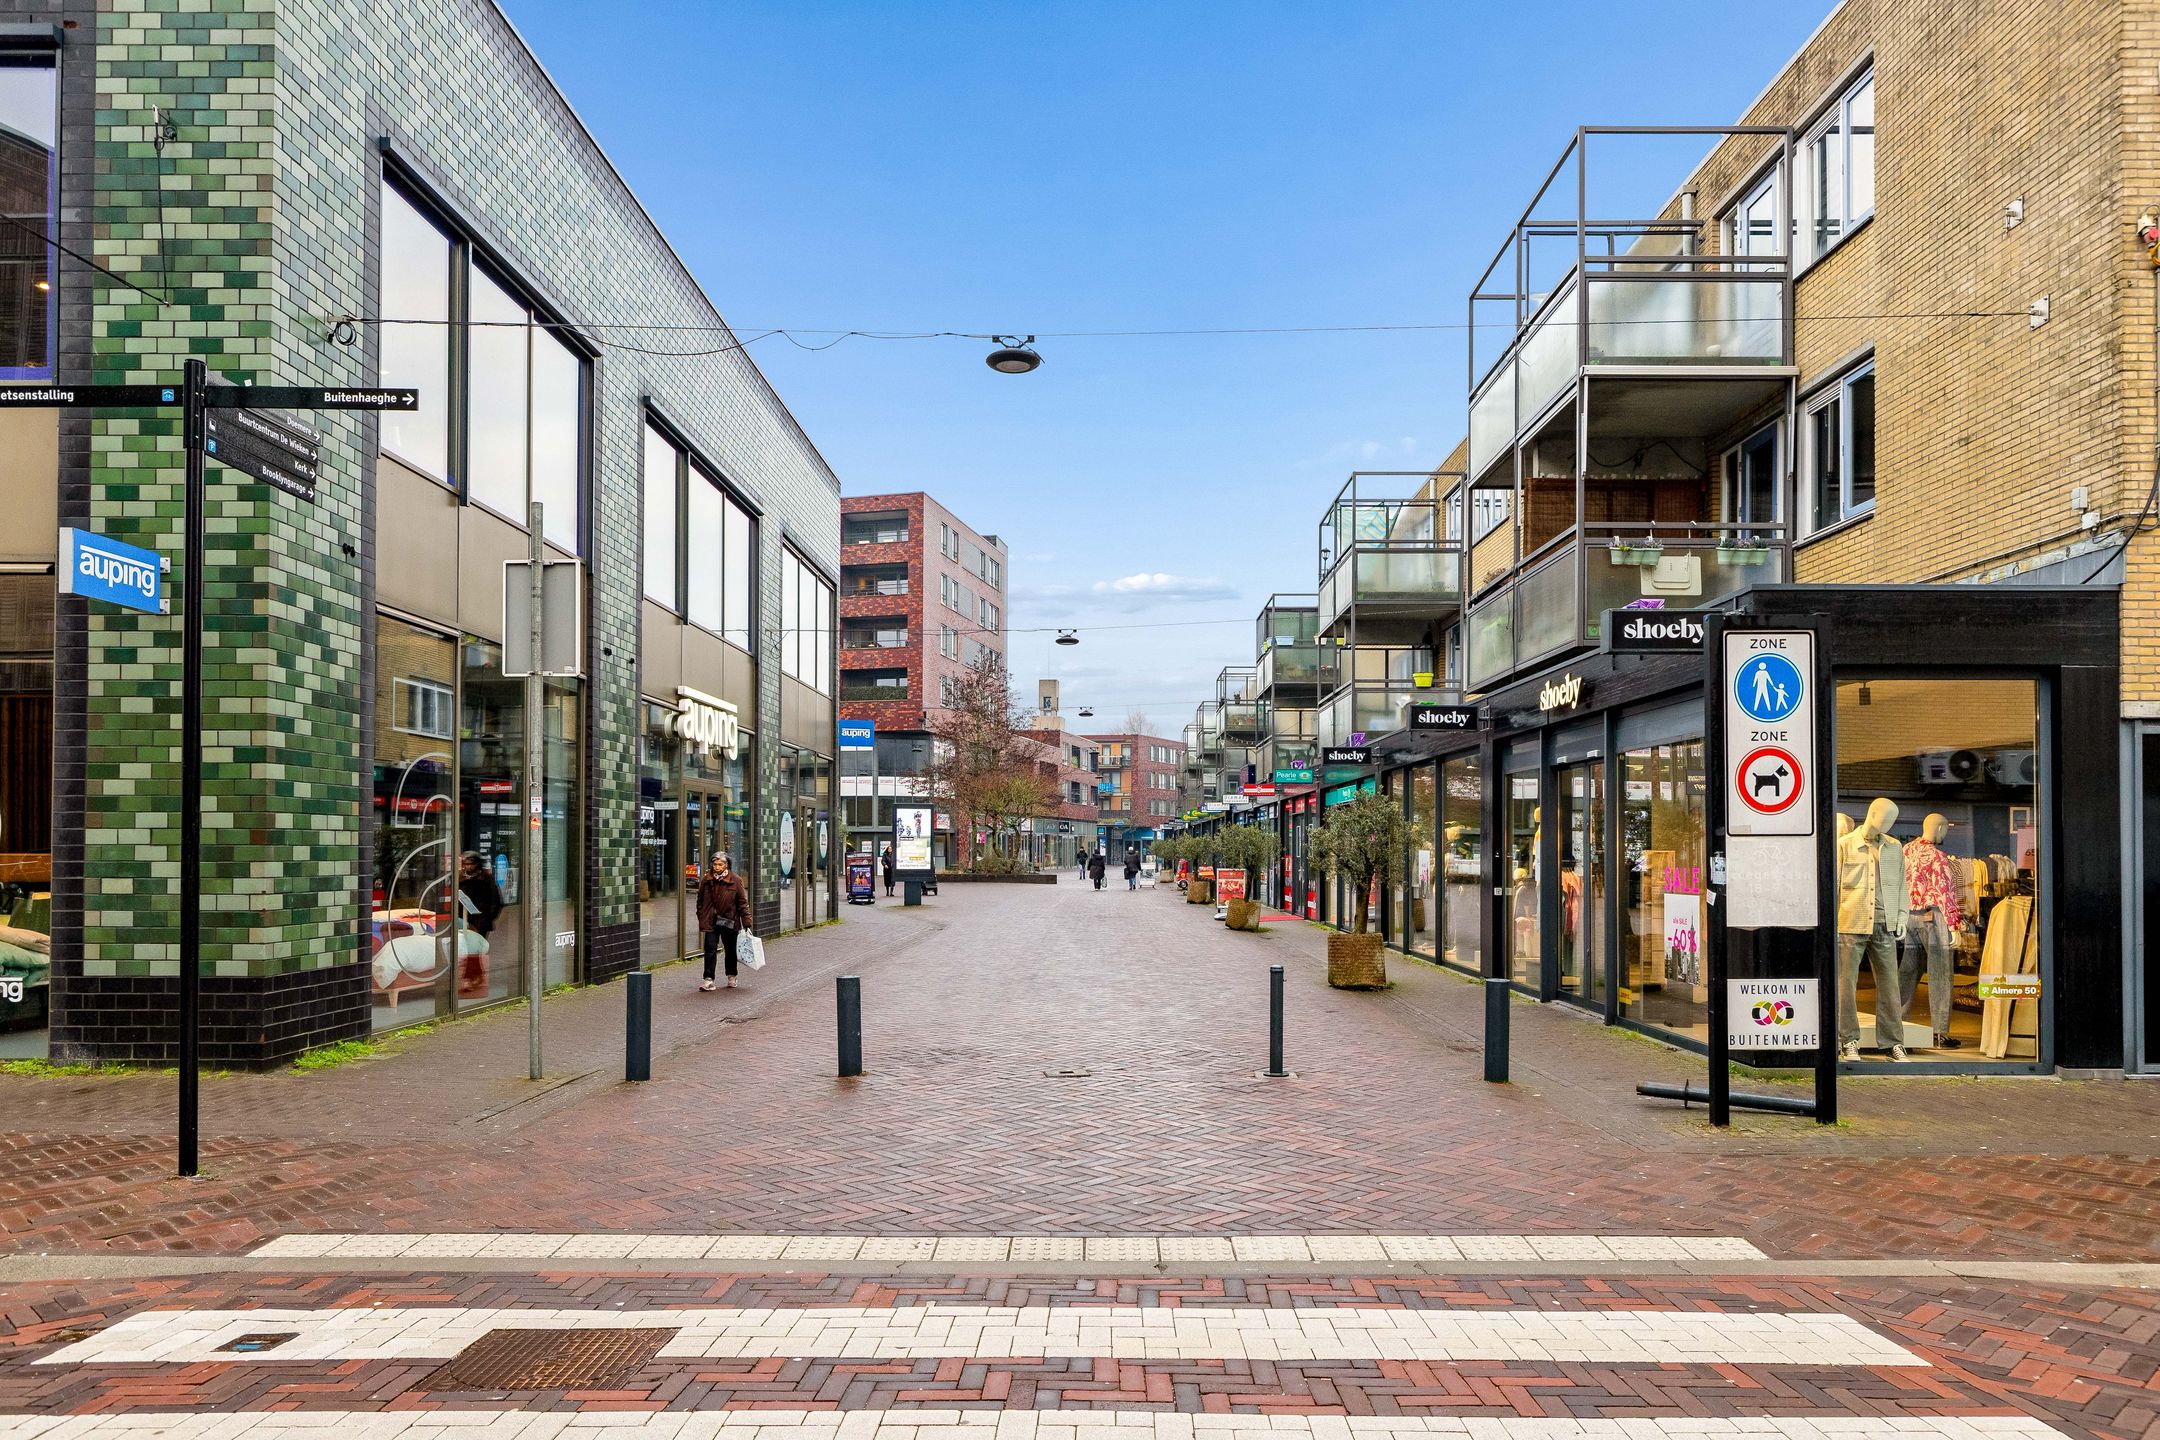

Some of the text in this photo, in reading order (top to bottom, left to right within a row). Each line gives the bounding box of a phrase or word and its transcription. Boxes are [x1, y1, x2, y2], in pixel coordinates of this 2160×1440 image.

[324, 392, 397, 405] Buitenhaeghe
[238, 411, 310, 456] Buurtcentrum De Wieken
[286, 416, 313, 436] Doemere
[294, 460, 308, 474] Kerk
[262, 465, 306, 494] Brooklyngarage
[79, 551, 155, 597] auping
[1623, 617, 1704, 644] shoeby
[1750, 638, 1787, 649] ZONE
[1539, 673, 1583, 711] shoeby
[677, 692, 738, 761] auping
[1418, 710, 1471, 727] shoeby
[841, 728, 871, 739] auping
[1751, 731, 1788, 742] ZONE
[1328, 750, 1366, 763] shoeby
[1664, 865, 1700, 894] SALE
[555, 932, 575, 948] auping
[1667, 928, 1698, 953] -60%
[1740, 984, 1806, 995] WELKOM IN
[1991, 986, 2037, 995] Almere 50
[1729, 1034, 1817, 1046] BUITENMERE
